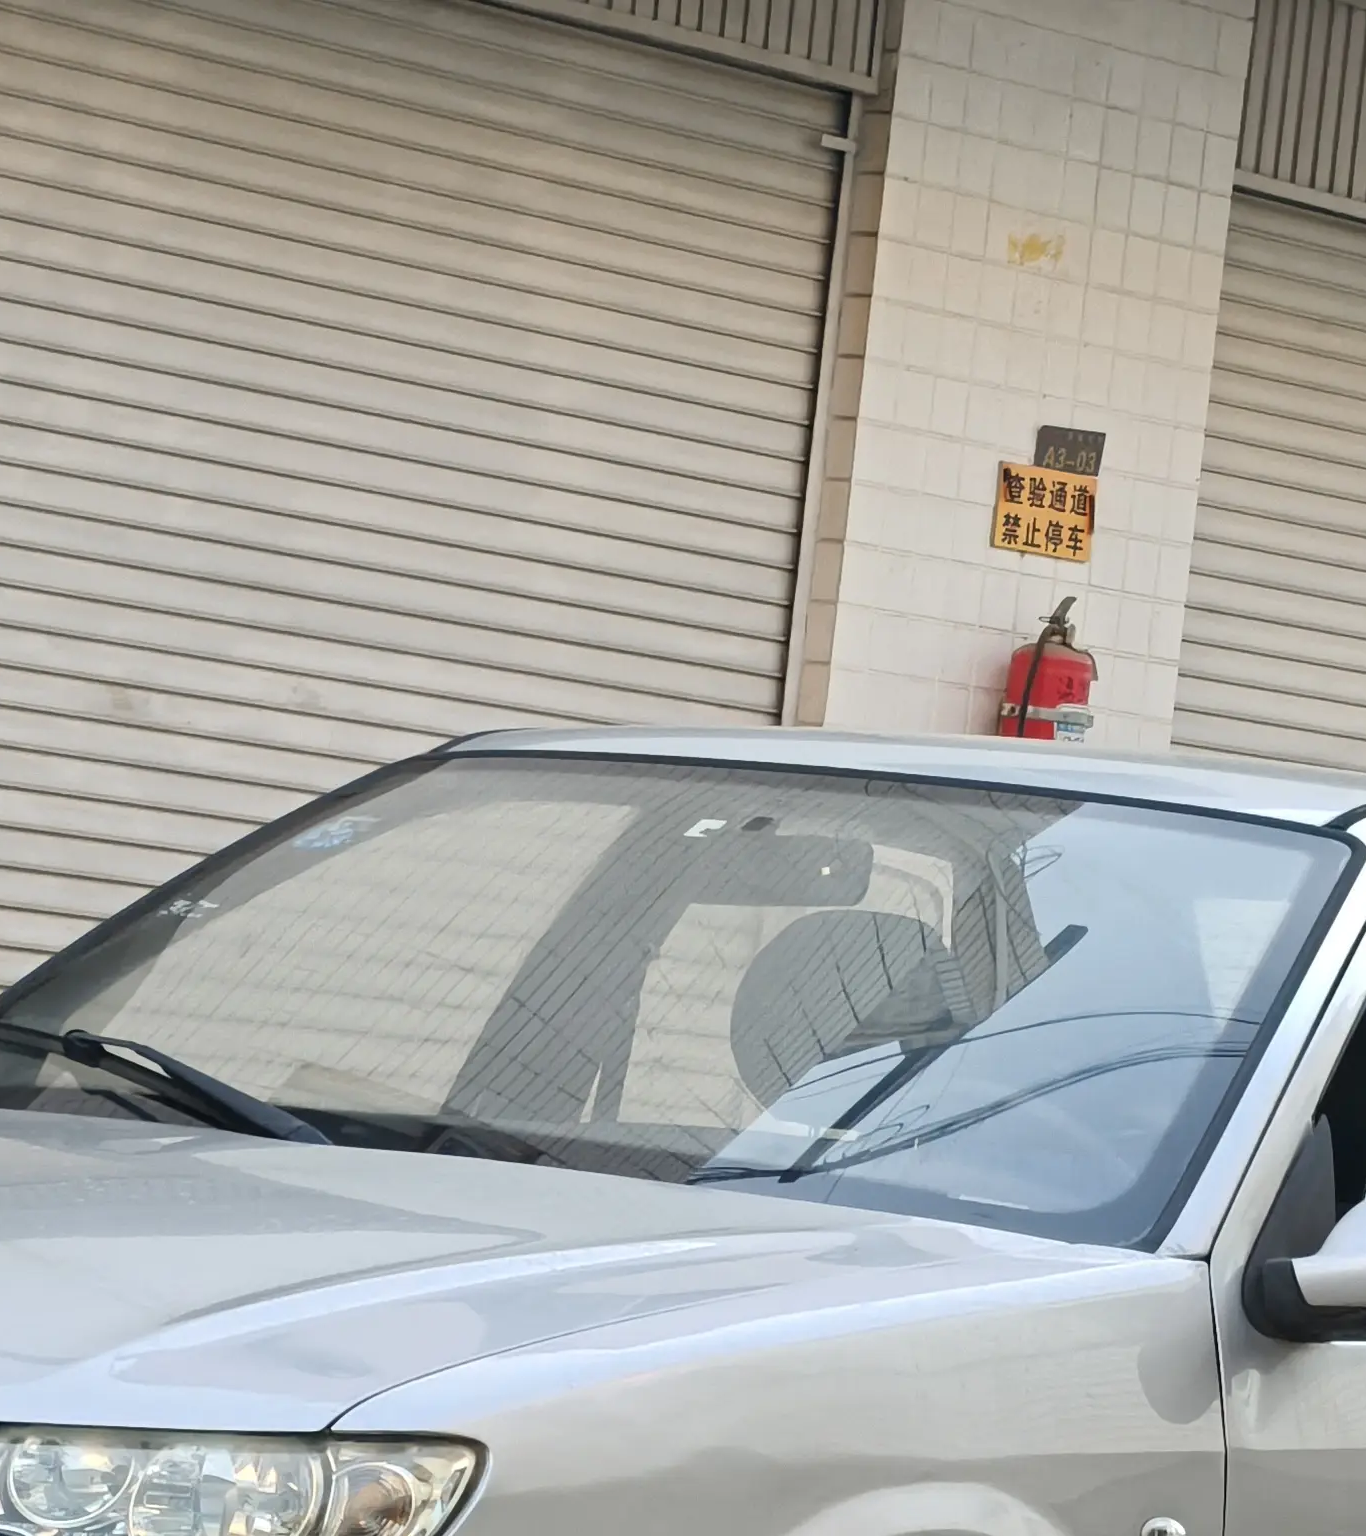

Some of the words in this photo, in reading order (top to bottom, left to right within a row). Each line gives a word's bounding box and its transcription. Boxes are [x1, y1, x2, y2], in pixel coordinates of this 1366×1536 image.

[1043, 446, 1097, 473] A3-03
[1004, 472, 1089, 516] 查验通道
[1001, 512, 1085, 556] 禁止停车
